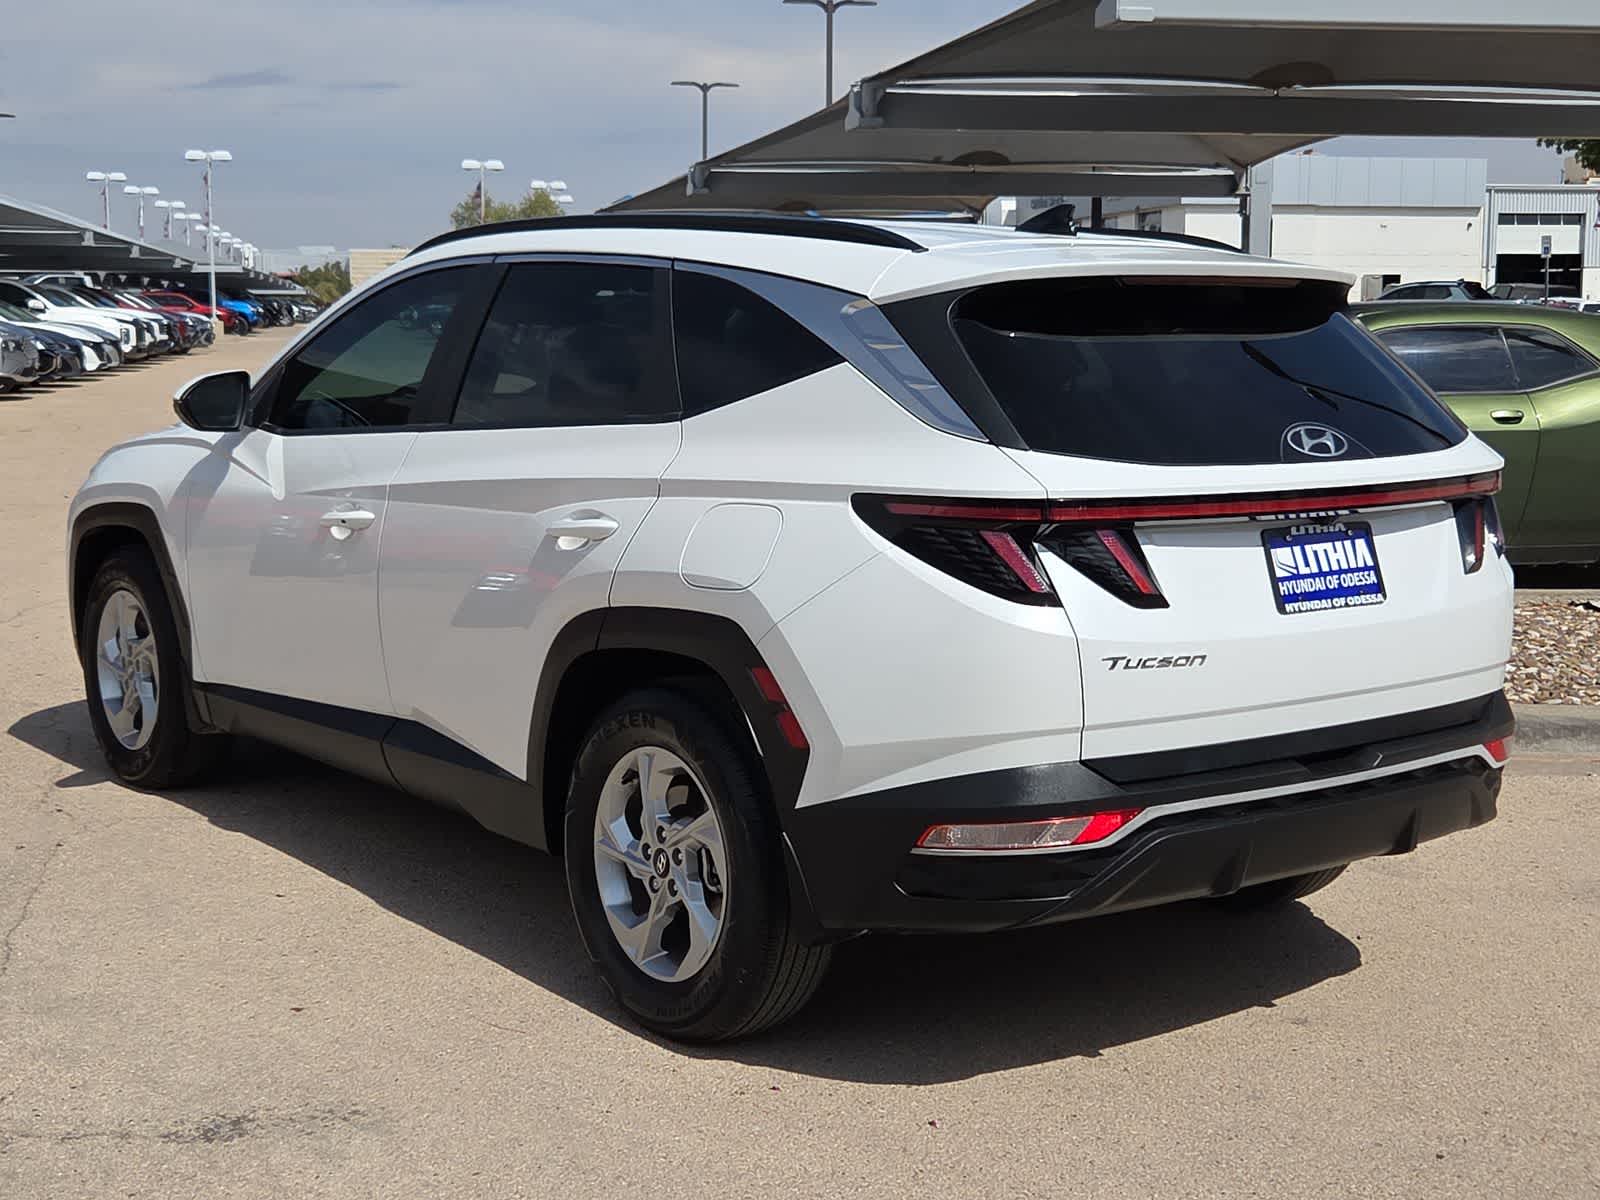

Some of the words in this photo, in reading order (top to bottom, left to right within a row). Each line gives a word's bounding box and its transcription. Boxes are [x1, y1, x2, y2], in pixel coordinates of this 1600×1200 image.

[1292, 538, 1374, 575] LITHIA
[1278, 577, 1327, 596] HYUNDAI
[1326, 575, 1340, 589] OF
[1341, 570, 1378, 588] ODESSA
[1285, 598, 1332, 613] HYUNDAI
[1333, 596, 1346, 607] OF
[1346, 593, 1384, 605] ODESSA
